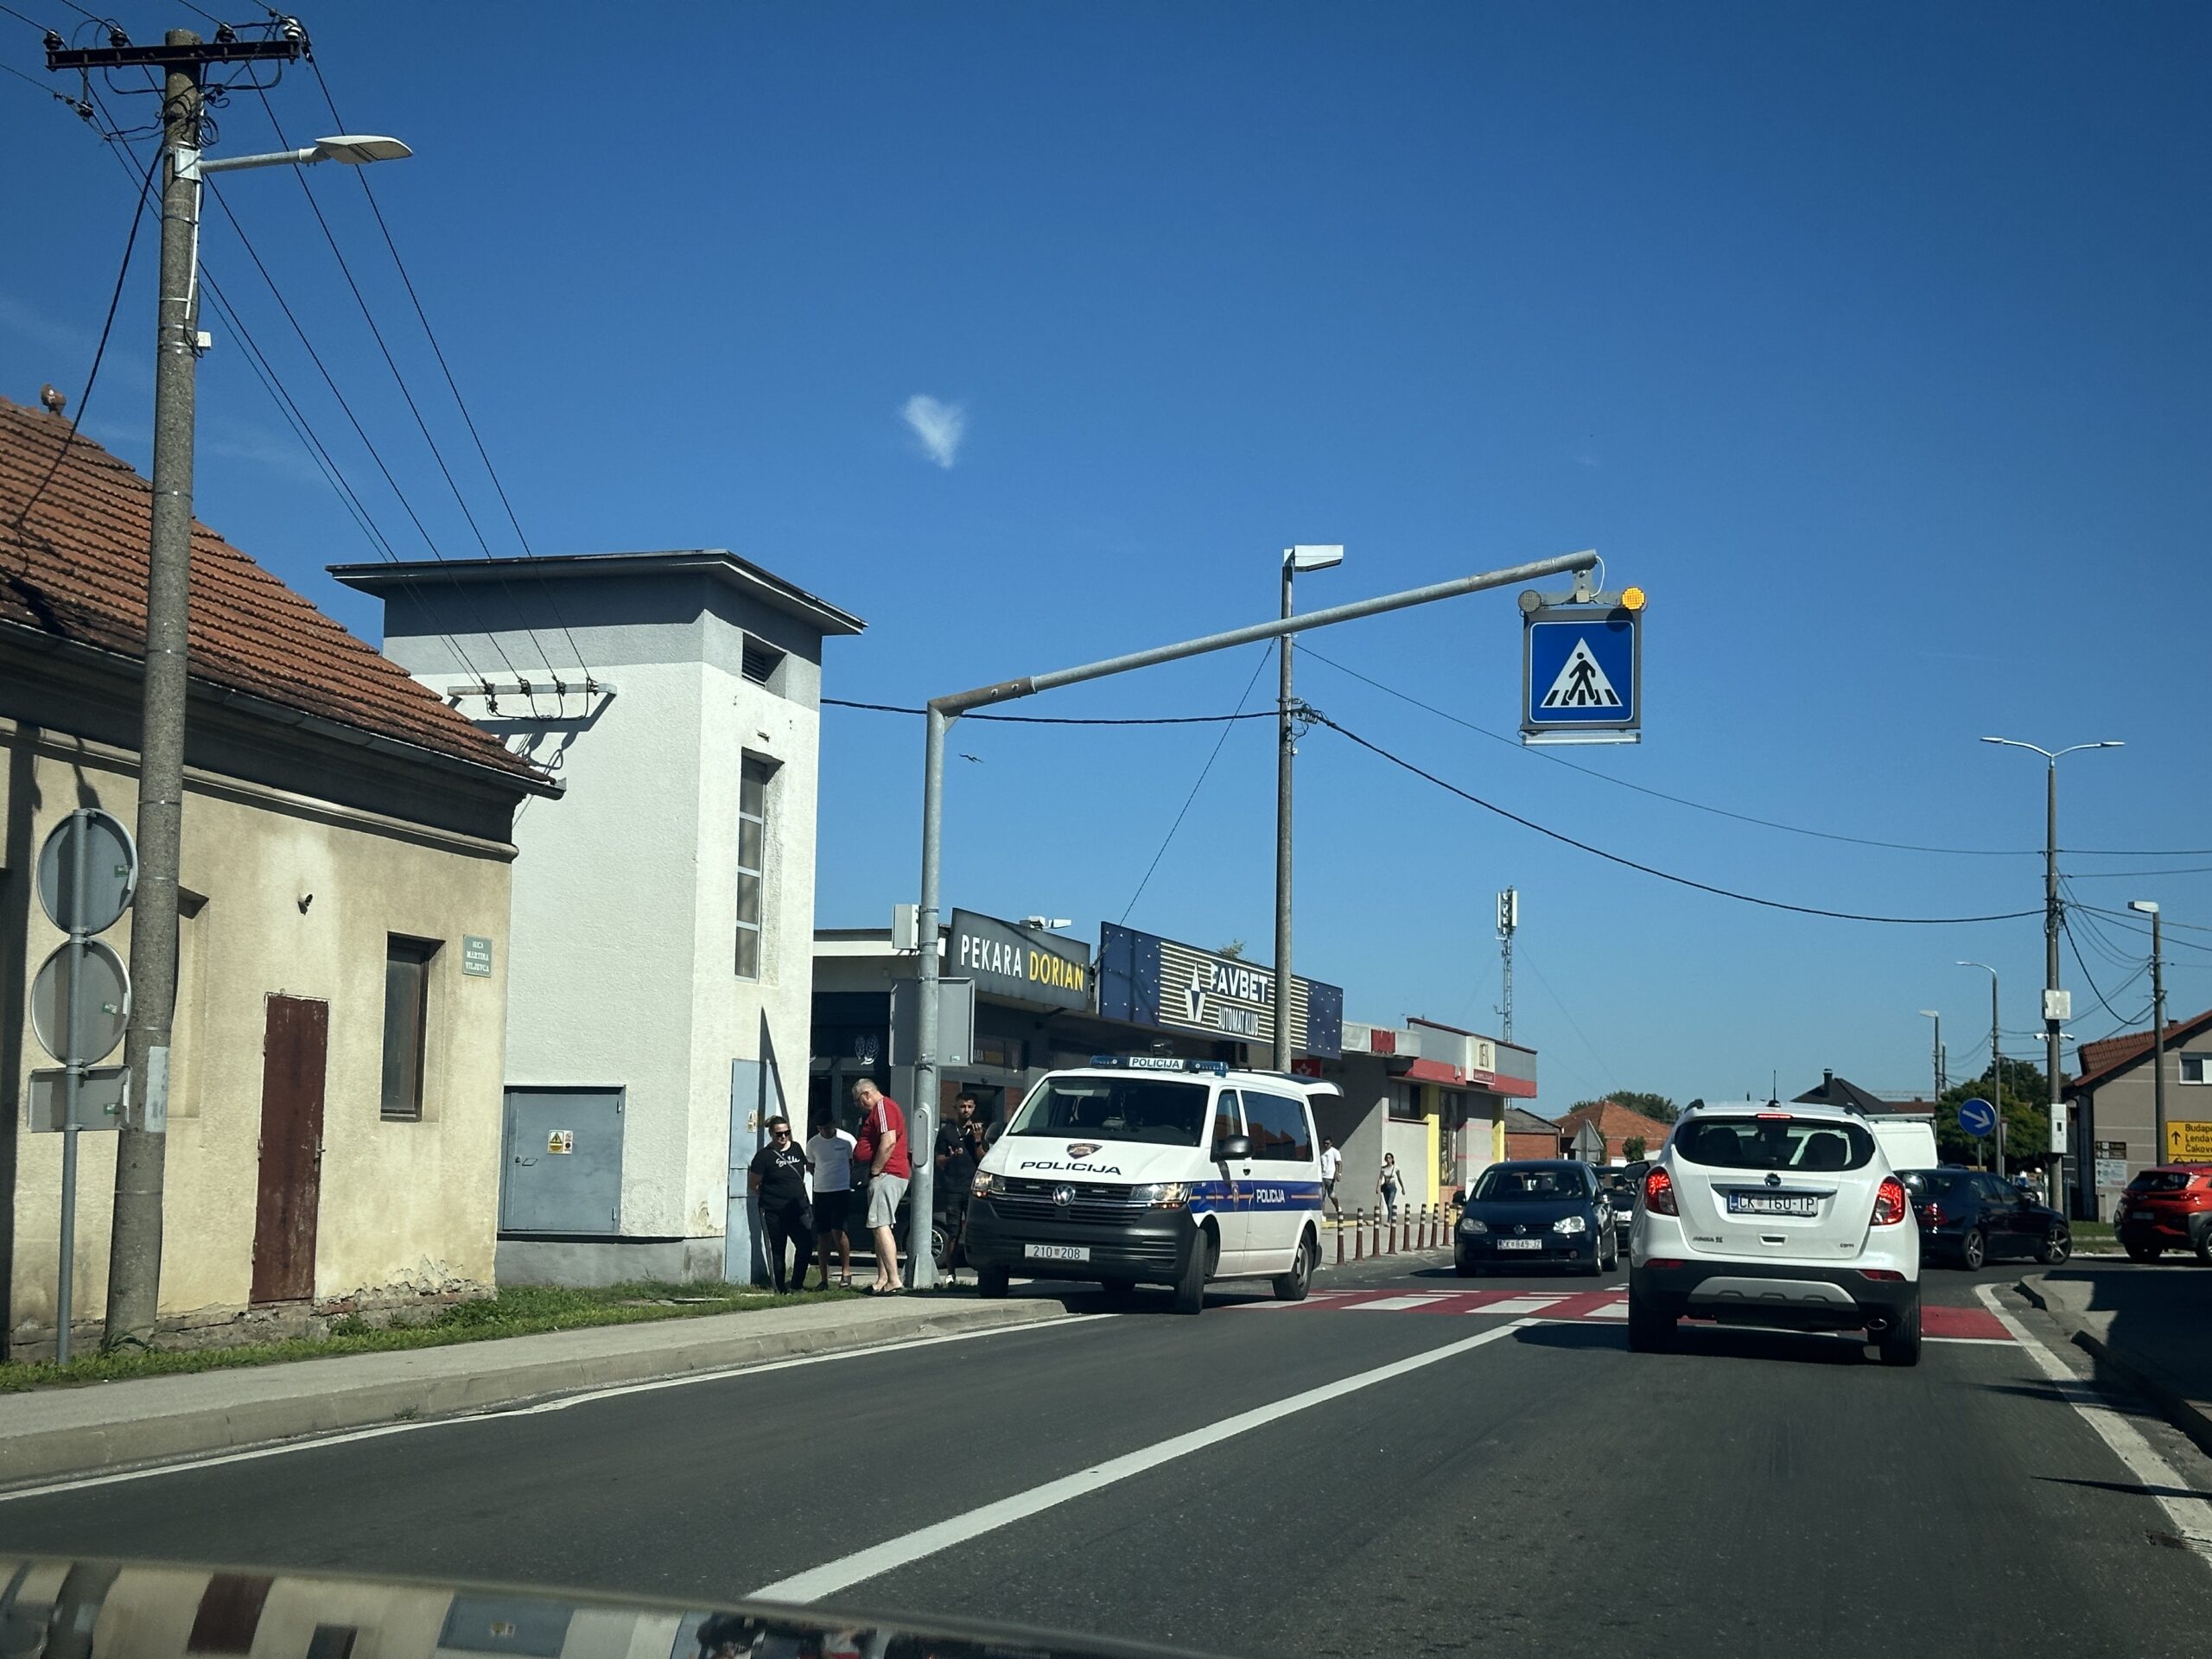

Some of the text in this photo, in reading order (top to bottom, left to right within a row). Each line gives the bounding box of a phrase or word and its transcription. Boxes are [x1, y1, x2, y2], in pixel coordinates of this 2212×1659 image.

[960, 934, 1084, 992] PEKARA DORIAN
[1210, 962, 1268, 1003] FAVBET
[1218, 1005, 1245, 1033] AUTOMAT
[1132, 1058, 1180, 1069] POLICIJA
[1020, 1161, 1122, 1176] POLICIJA
[1256, 1188, 1286, 1204] POLICIJA
[1739, 1195, 1755, 1209] CK
[1033, 1245, 1080, 1260] 210 208
